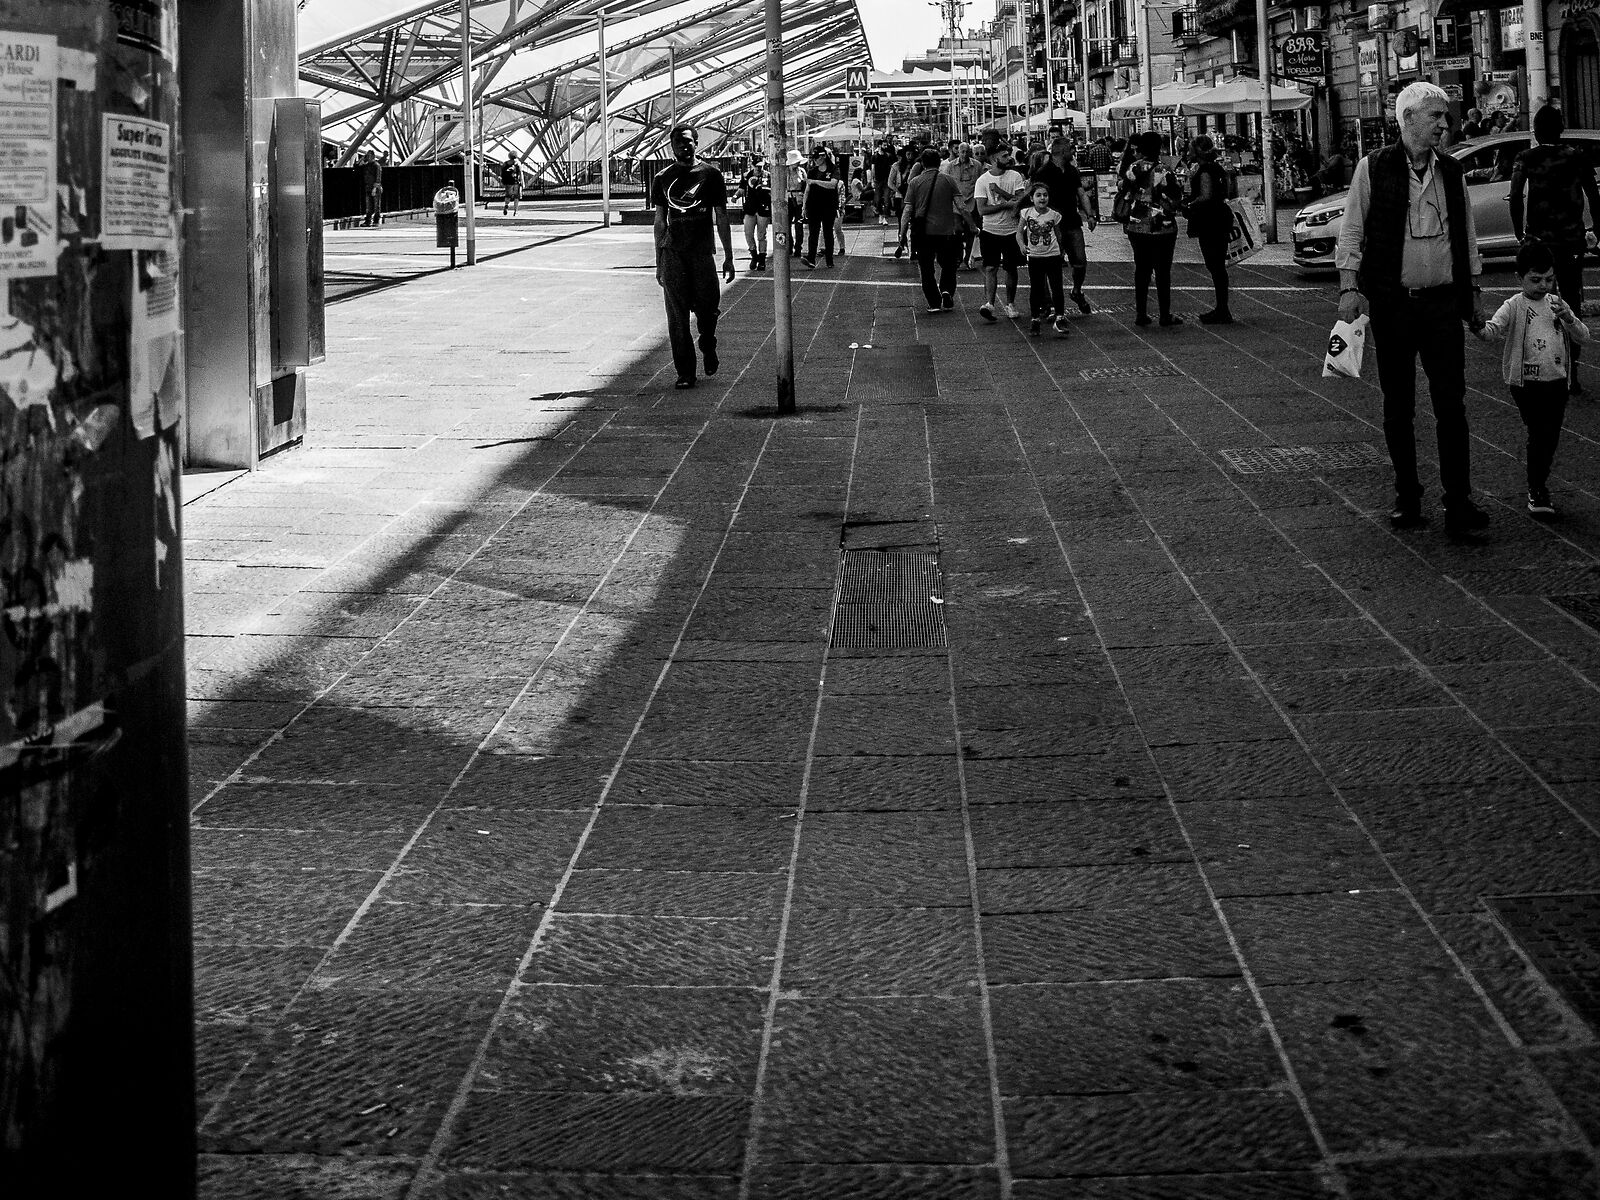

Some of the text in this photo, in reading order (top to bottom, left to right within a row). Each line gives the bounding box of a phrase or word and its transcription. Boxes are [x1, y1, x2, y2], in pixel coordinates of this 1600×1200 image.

[1286, 37, 1320, 53] BAR
[1286, 66, 1322, 76] TORALDO
[849, 72, 866, 87] M
[865, 99, 878, 110] M
